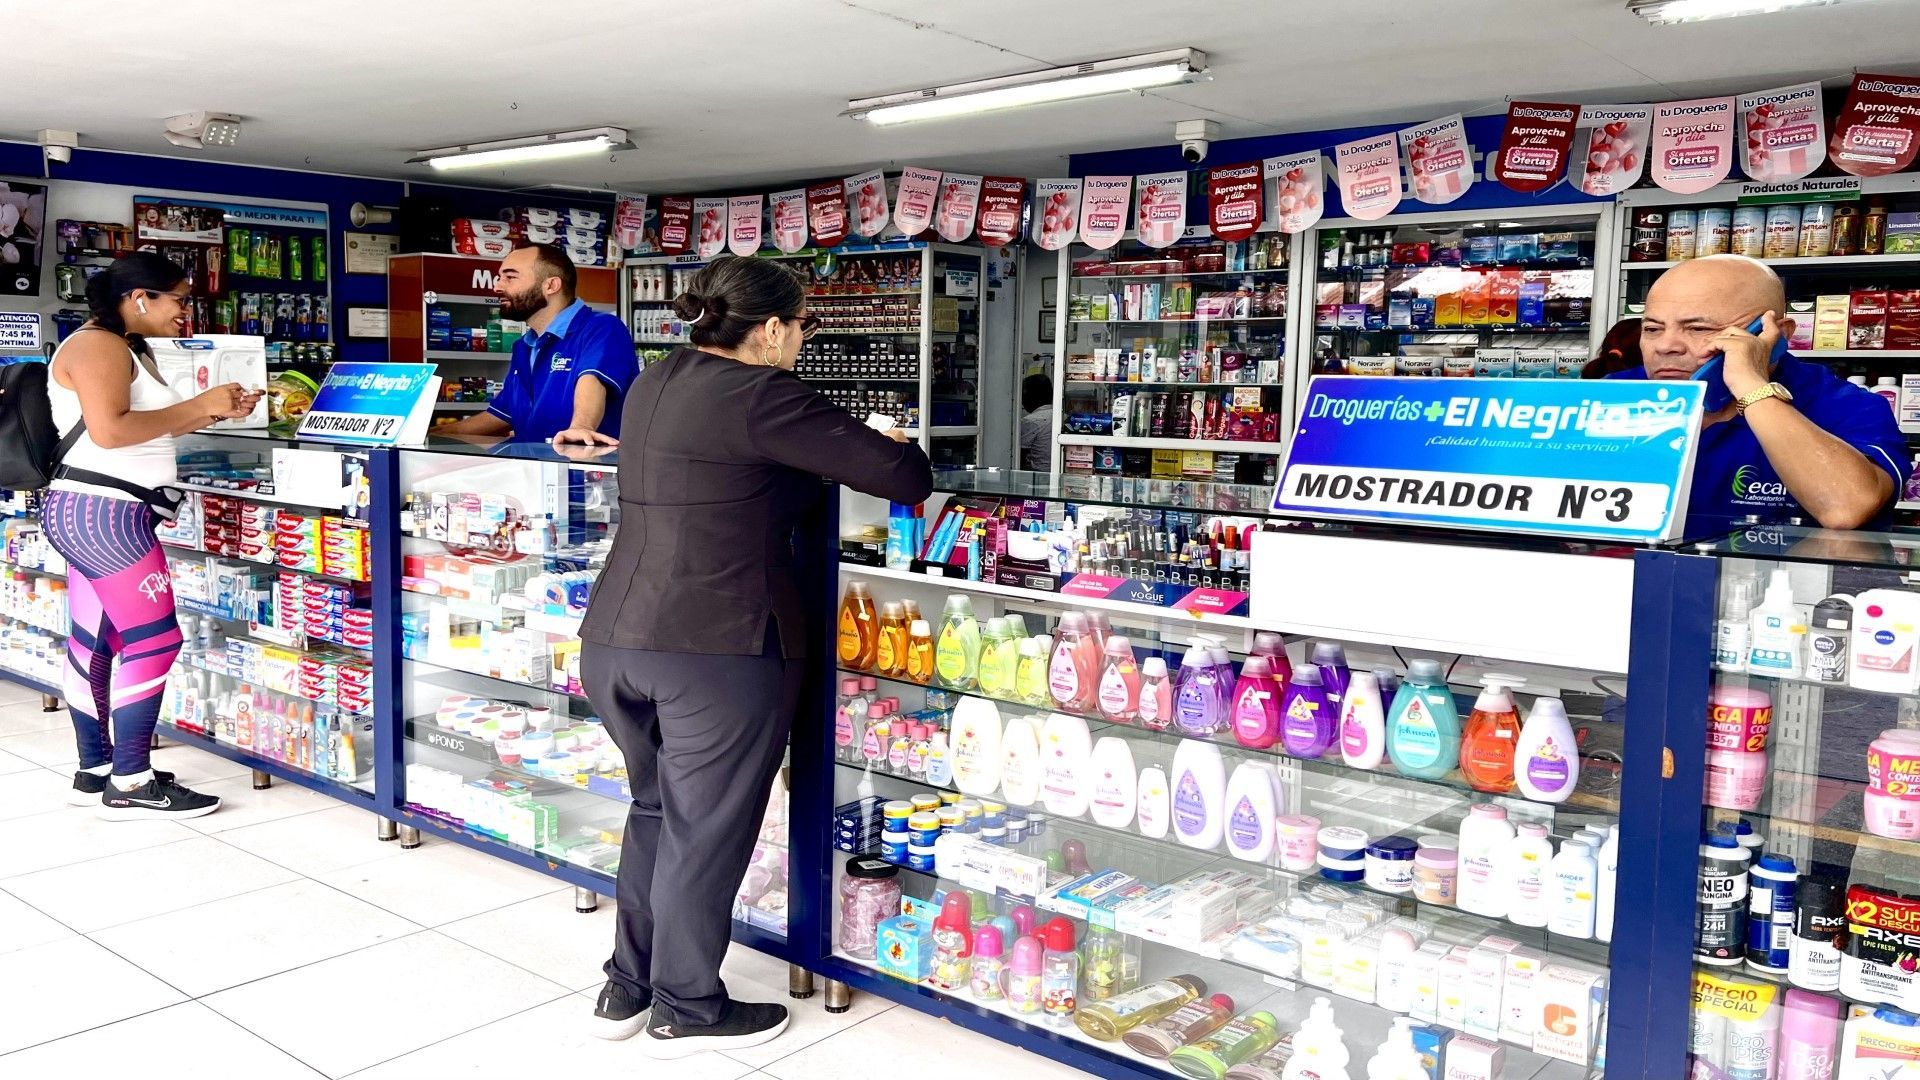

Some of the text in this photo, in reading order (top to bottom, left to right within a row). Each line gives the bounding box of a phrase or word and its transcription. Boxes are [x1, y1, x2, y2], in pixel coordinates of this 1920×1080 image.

[1858, 79, 1872, 91] tu
[1743, 100, 1754, 109] tu
[1514, 107, 1523, 117] tu
[1583, 111, 1593, 121] tu
[1660, 108, 1671, 117] tu
[1767, 104, 1817, 118] Aprovecha
[1790, 113, 1809, 122] dile
[1866, 113, 1900, 124] y dile
[1511, 126, 1566, 138] Aprovecha
[1662, 122, 1726, 137] Aprovecha
[1404, 132, 1413, 142] tu
[1424, 133, 1462, 149] Aprovecha
[1520, 134, 1548, 146] y dile
[1675, 132, 1706, 145] y dile
[1767, 132, 1814, 146] Ofertas
[1852, 135, 1903, 149] Ofertas
[1340, 148, 1350, 157] tu
[1344, 156, 1393, 173] Aprovecha
[1426, 156, 1463, 173] Ofertas
[1511, 156, 1552, 167] Ofertas
[1668, 153, 1716, 167] Ofertas
[1214, 183, 1258, 196] Aprovecha
[1354, 184, 1390, 197] Ofertas
[1742, 179, 1859, 194] Productos Naturales
[244, 210, 277, 221] MEJOR
[279, 213, 306, 223] PARA
[308, 216, 315, 224] TI
[1150, 209, 1179, 219] Ofertas
[1220, 208, 1253, 220] Ofertas
[1090, 219, 1118, 228] Ofertas
[361, 374, 373, 390] El
[370, 373, 413, 396] Negrito
[1308, 393, 1630, 440] Droguerías El Negrito
[304, 415, 370, 433] MOSTRADOR
[1425, 435, 1620, 453] ¡Calidad humana a su servicio
[1294, 473, 1533, 513] MOSTRADOR
[279, 517, 301, 526] Colgate
[279, 536, 301, 545] Colgate
[280, 552, 305, 562] Colgate
[303, 583, 326, 593] Colgate
[303, 596, 326, 607] Colgate
[1130, 591, 1165, 602] VOGUE
[304, 610, 327, 620] Colgate
[343, 612, 372, 623] Colgate
[306, 622, 328, 633] Colgate
[344, 630, 372, 640] Colgate
[338, 666, 365, 679] Colgate
[338, 695, 366, 708] Colgate
[435, 734, 464, 752] POND'S
[1555, 872, 1585, 881] LANDER
[1702, 878, 1734, 892] NEO
[1845, 898, 1878, 925] X2
[1703, 921, 1726, 931] 24H
[1811, 915, 1845, 927] AXE
[1862, 927, 1920, 948] AXE
[1862, 940, 1896, 952] EPIC FRESH
[1861, 969, 1913, 984] ANTITRANSPIRANTE
[1860, 1036, 1896, 1050] PRECIO
